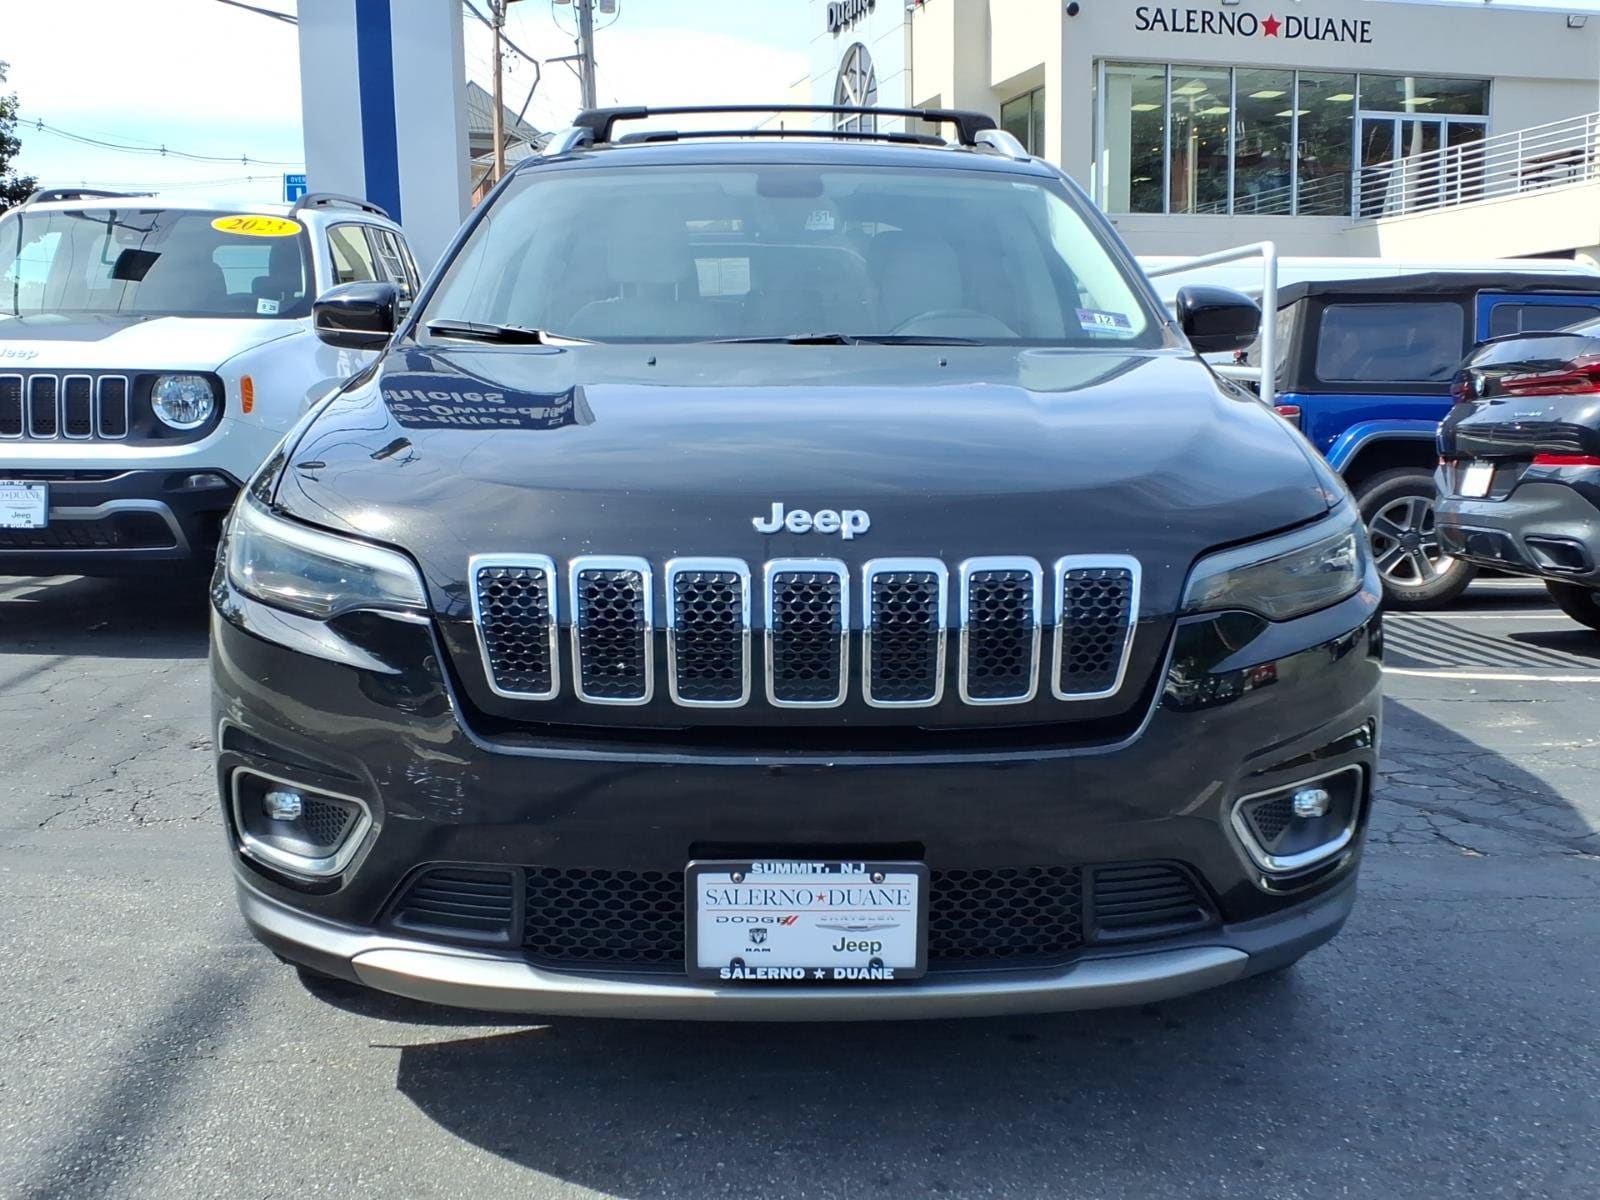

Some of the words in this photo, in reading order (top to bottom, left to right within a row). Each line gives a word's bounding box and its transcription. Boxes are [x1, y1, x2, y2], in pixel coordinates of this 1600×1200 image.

[1135, 6, 1258, 37] SALERNO
[1285, 15, 1373, 43] DUANE
[225, 218, 287, 231] 2023
[752, 502, 870, 540] Jeep
[840, 863, 865, 874] NJ
[706, 889, 813, 906] SALERNO
[829, 889, 911, 906] DUANE
[716, 916, 785, 924] DODGE
[833, 937, 882, 955] Jeep
[720, 967, 805, 980] SALERNO
[834, 967, 893, 980] DUANE
